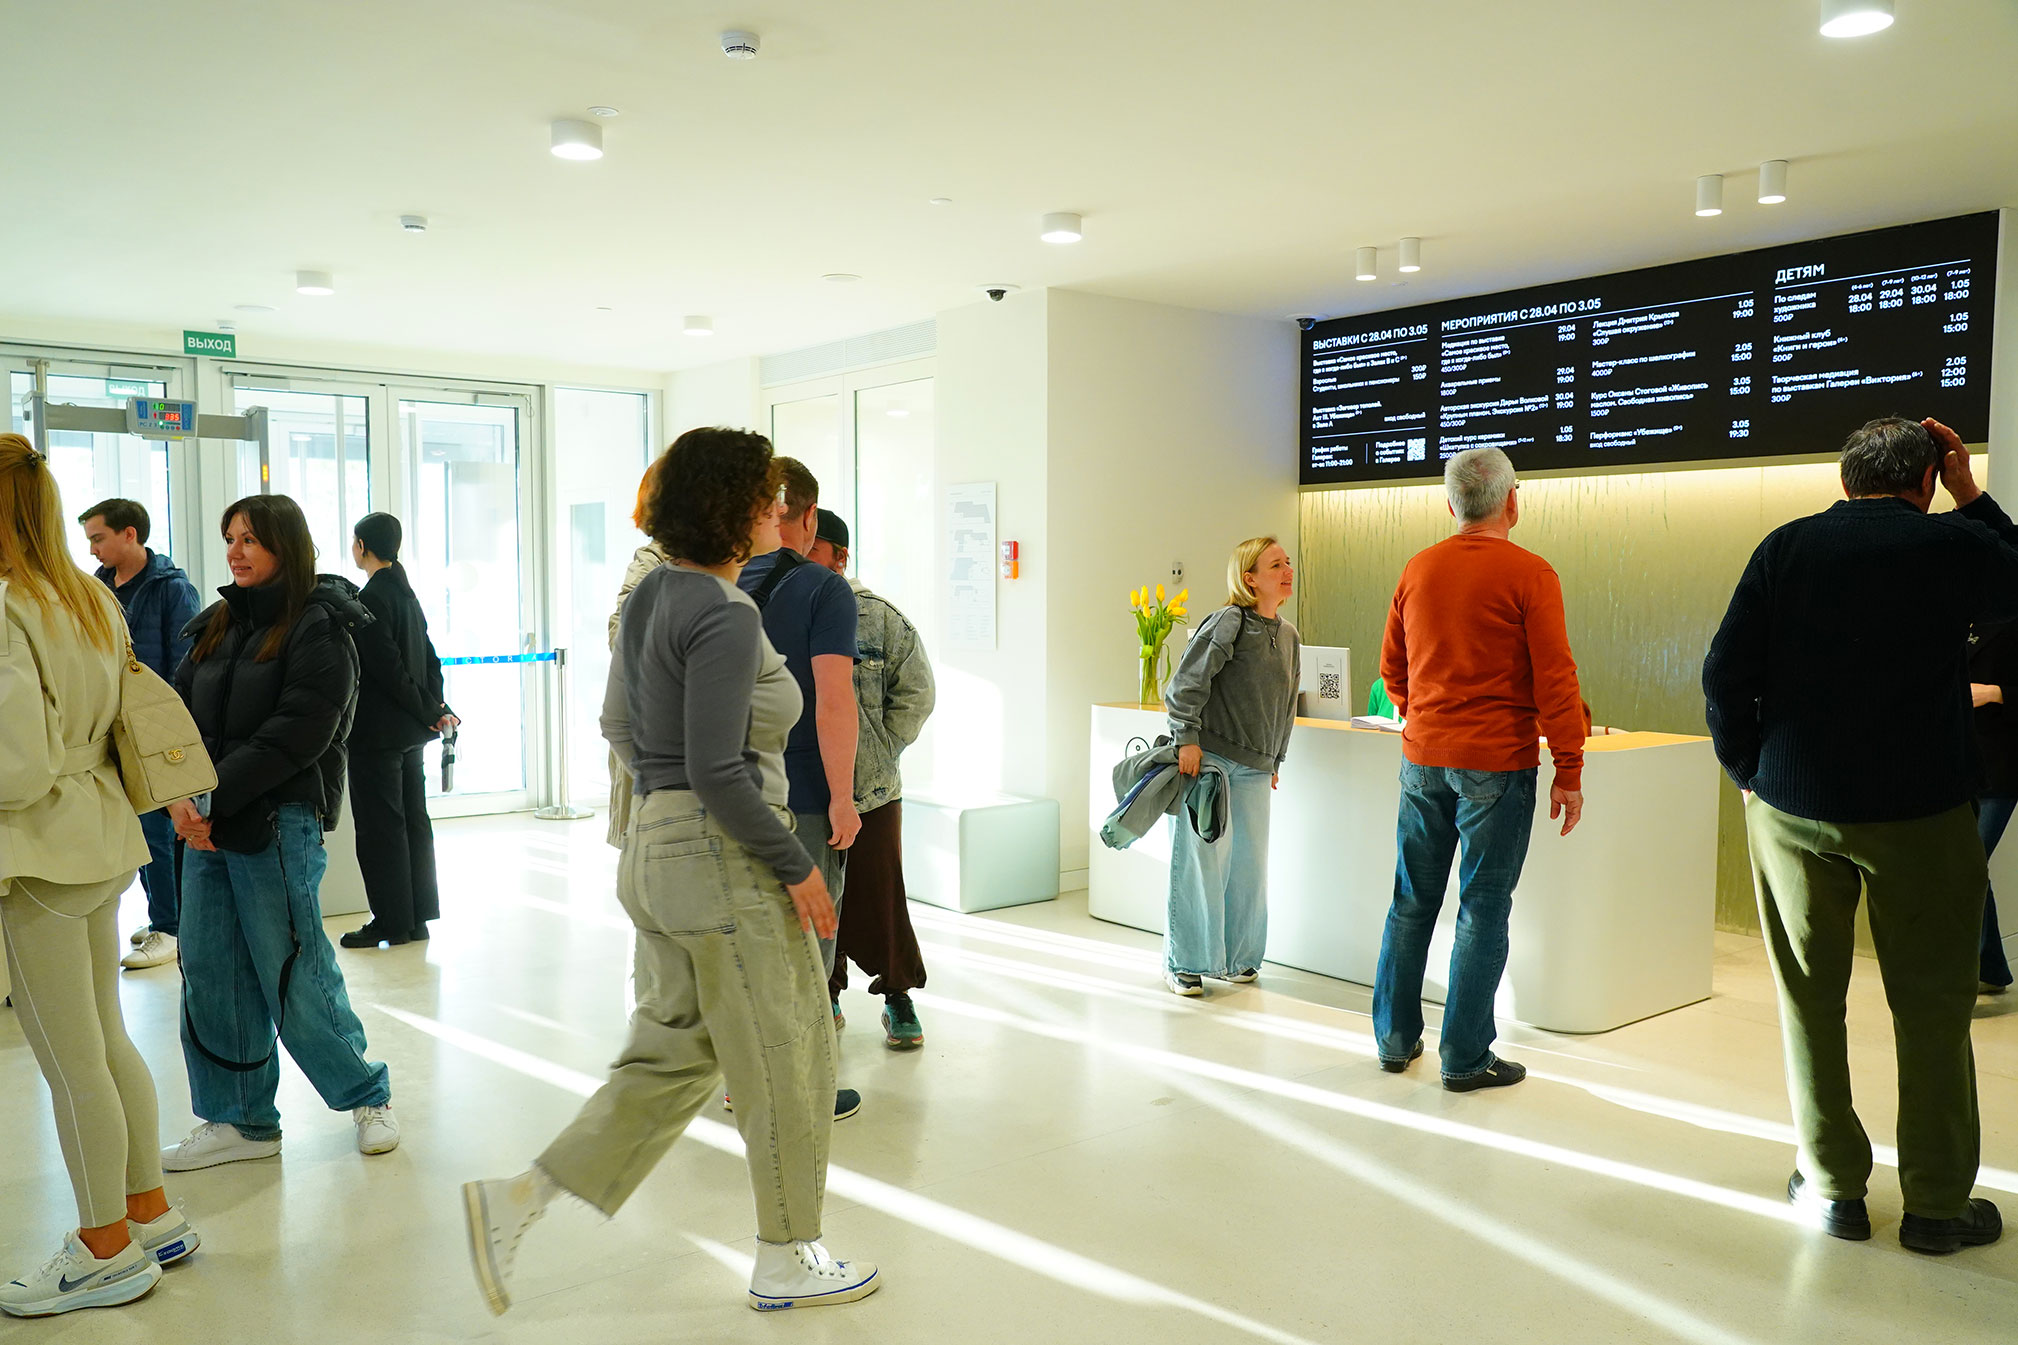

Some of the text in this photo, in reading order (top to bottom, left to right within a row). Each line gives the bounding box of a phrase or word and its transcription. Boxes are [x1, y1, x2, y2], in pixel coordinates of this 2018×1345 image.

[1775, 264, 1825, 284] ДЕТЯМ
[1951, 279, 1970, 289] 1.05
[1880, 288, 1903, 300] 29.04
[1911, 284, 1937, 295] 30.04
[1774, 292, 1816, 303] По следам
[1848, 293, 1872, 304] 28.04
[1912, 294, 1936, 304] 18:00
[1944, 290, 1969, 300] 18:00
[1738, 299, 1754, 308] 1.05
[1774, 301, 1816, 315] художника
[1848, 302, 1872, 313] 18:00
[1879, 299, 1903, 309] 18:00
[1442, 298, 1601, 332] МЕРОПРИЯТИЯ С 28.04 ПО 3.05
[1733, 309, 1753, 318] 19:00
[1950, 312, 1968, 322] 1.05
[1618, 316, 1648, 326] Дмитрия
[1558, 324, 1576, 334] 29.04
[1943, 323, 1968, 333] 15:00
[1313, 324, 1428, 351] ВЫСТАВКИ С 28.04 ПО 3.05
[1558, 332, 1575, 341] 19:00
[1774, 329, 1831, 344] Книжный клуб
[187, 337, 232, 353] ВЫХОД
[1735, 343, 1752, 352] 2.05
[1773, 344, 1801, 352] «Книги
[1592, 358, 1638, 369] Мастер-класс
[1649, 351, 1696, 362] шелкографии
[1731, 352, 1752, 361] 15:00
[1946, 356, 1966, 366] 2.05
[1557, 367, 1574, 376] 29.04
[1941, 367, 1966, 377] 12:00
[1557, 375, 1574, 383] 19:00
[1733, 377, 1751, 385] 3.05
[1772, 370, 1859, 385] Творческая медиация
[1941, 377, 1965, 387] 15:00
[1783, 382, 1825, 392] выставкам
[1826, 378, 1860, 388] Галереи
[1861, 375, 1911, 384] «Виктория»
[1591, 392, 1607, 400] Курс
[1608, 390, 1634, 398] Оксаны
[1730, 386, 1750, 395] 15:00
[1555, 392, 1574, 400] 30.04
[1617, 396, 1655, 405] Свободная
[1732, 420, 1749, 428] 3.05
[1556, 434, 1573, 442] 18:30
[1590, 431, 1633, 441] Перформанс
[1729, 429, 1749, 438] 19:30
